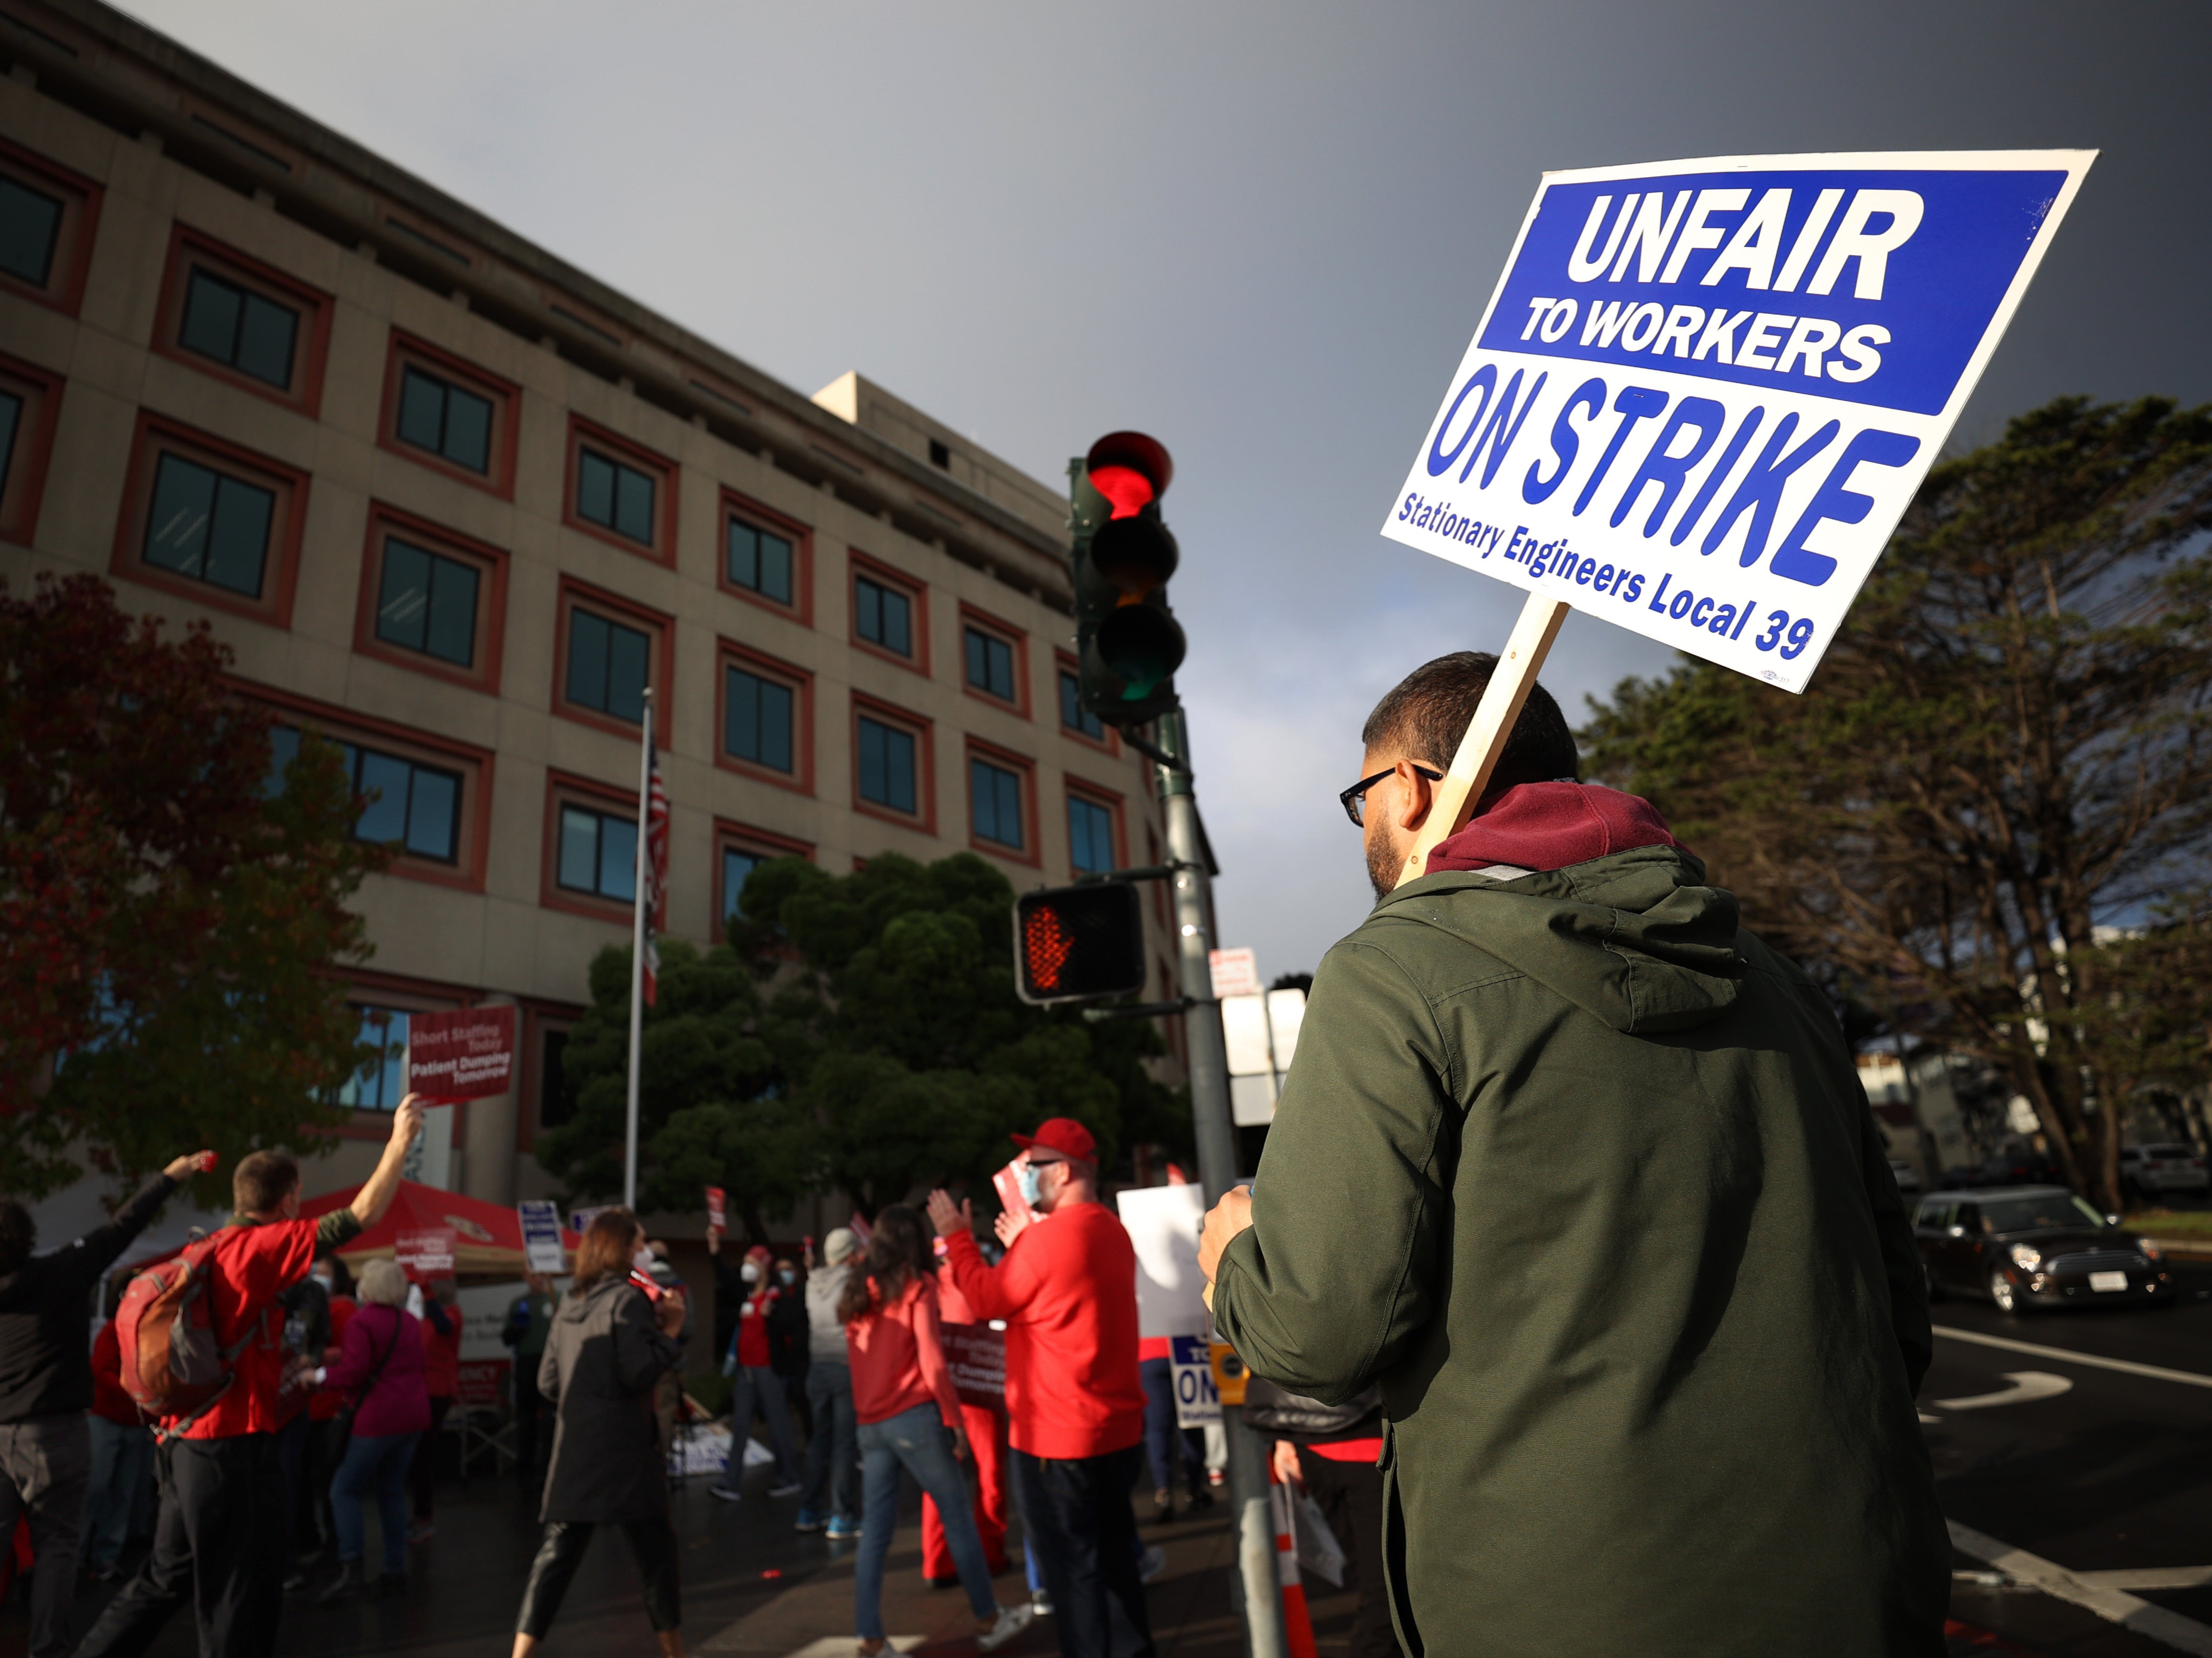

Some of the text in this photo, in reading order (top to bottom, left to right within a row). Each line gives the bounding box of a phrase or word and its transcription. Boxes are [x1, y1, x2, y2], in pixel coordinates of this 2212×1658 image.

[1568, 189, 1924, 300] UNFAIR
[1521, 297, 1891, 383] TO WORKERS
[1427, 364, 1920, 586] ON STRIKE
[1398, 492, 1813, 660] Stationary Engineers Local 39
[411, 1053, 511, 1078] Patient Dumping
[412, 1030, 448, 1046] Short
[453, 1066, 508, 1085] Tomorrow
[1179, 1369, 1219, 1406] ON
